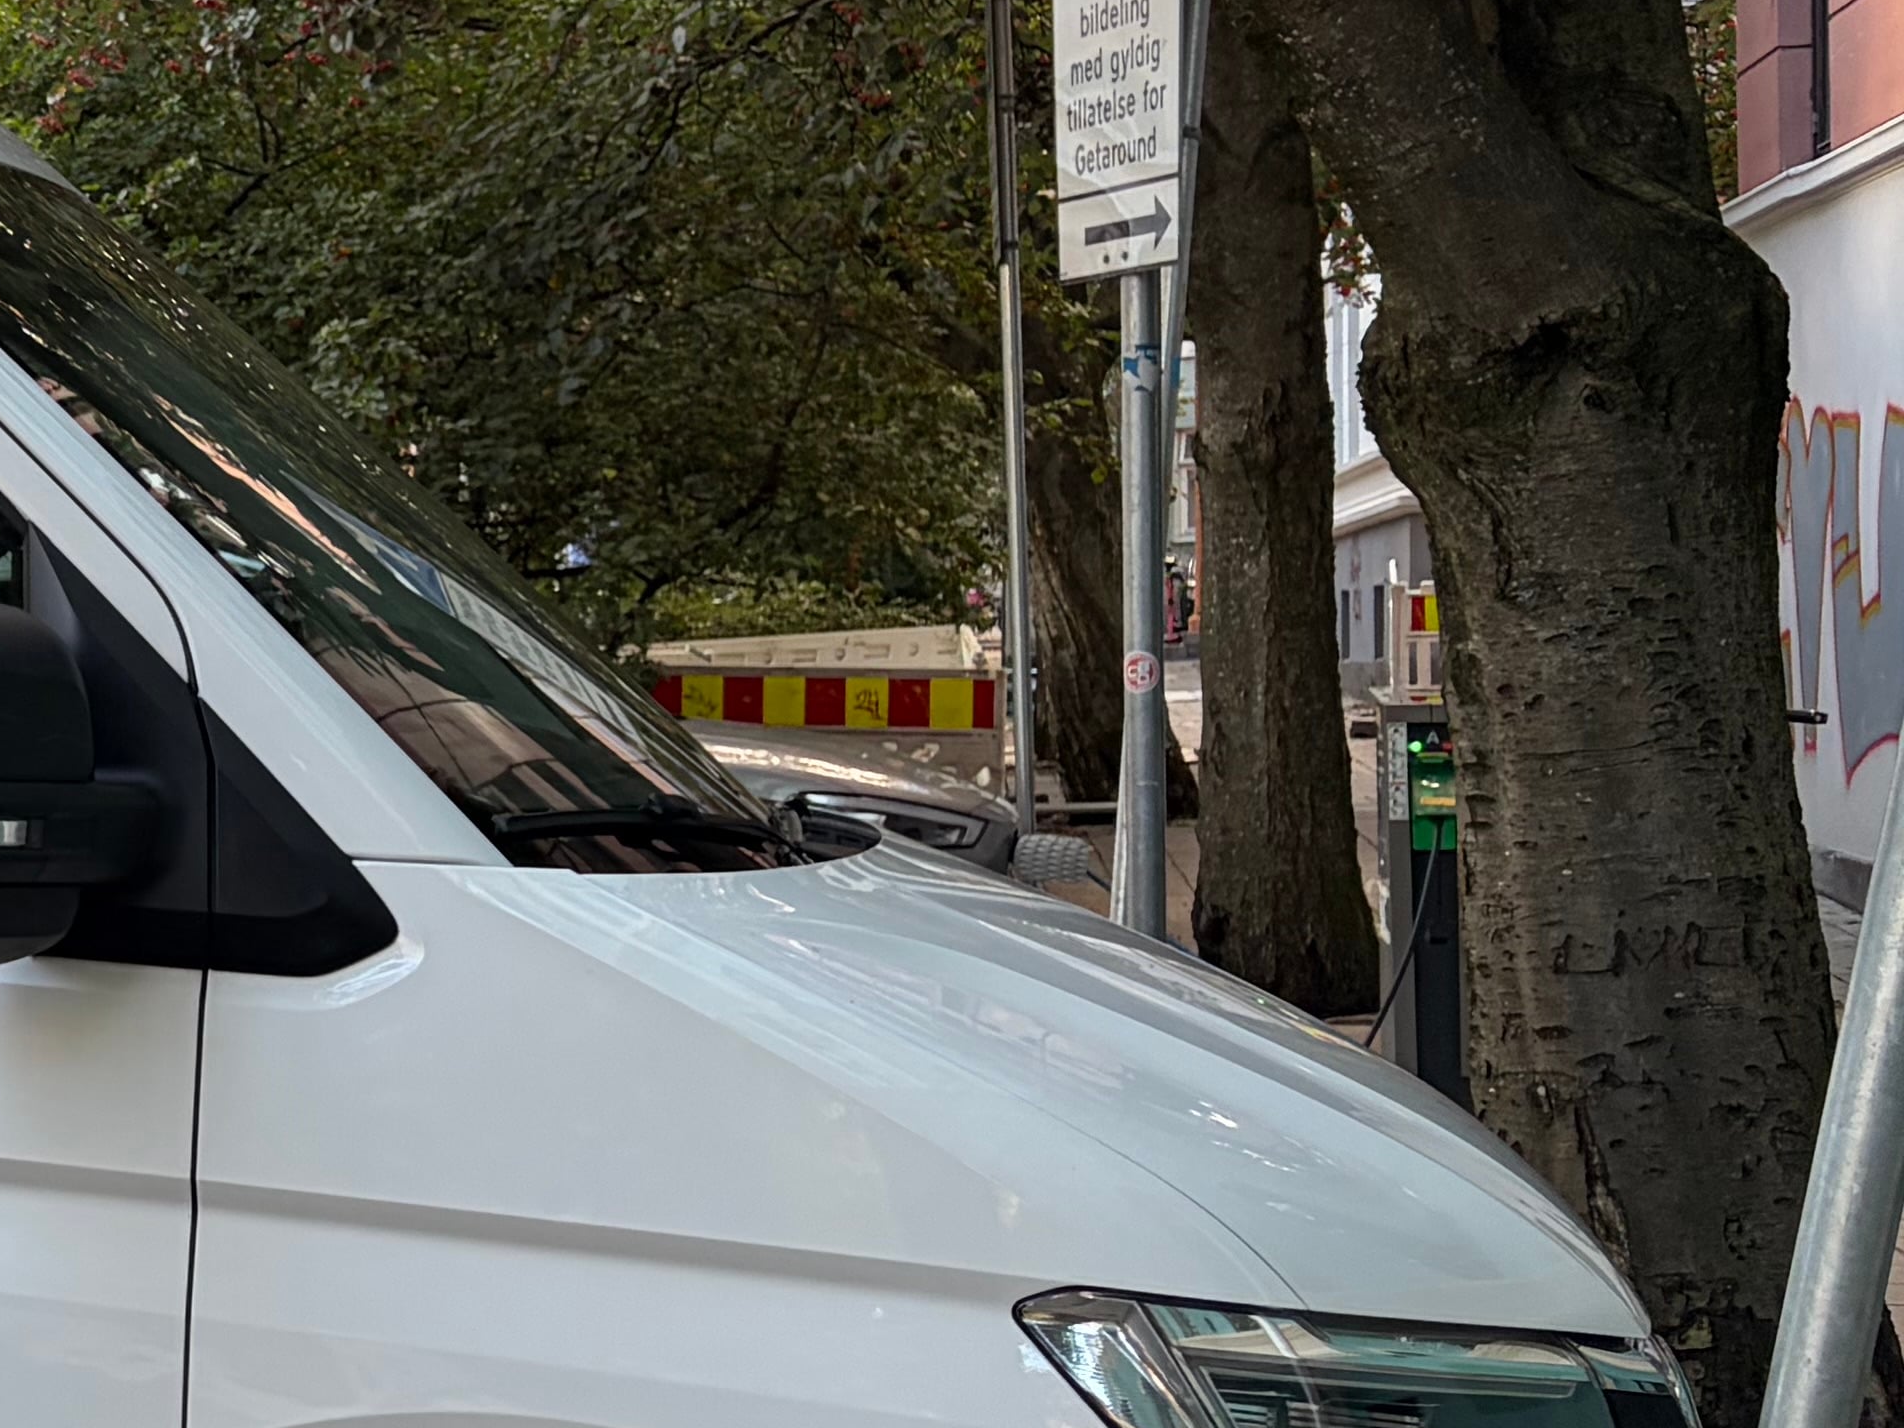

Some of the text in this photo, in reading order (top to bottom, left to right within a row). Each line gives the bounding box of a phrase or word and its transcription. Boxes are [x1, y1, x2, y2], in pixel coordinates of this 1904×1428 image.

[1070, 34, 1161, 87] med gyldig
[1067, 80, 1167, 132] tillatelse for
[1075, 126, 1157, 176] Getaround
